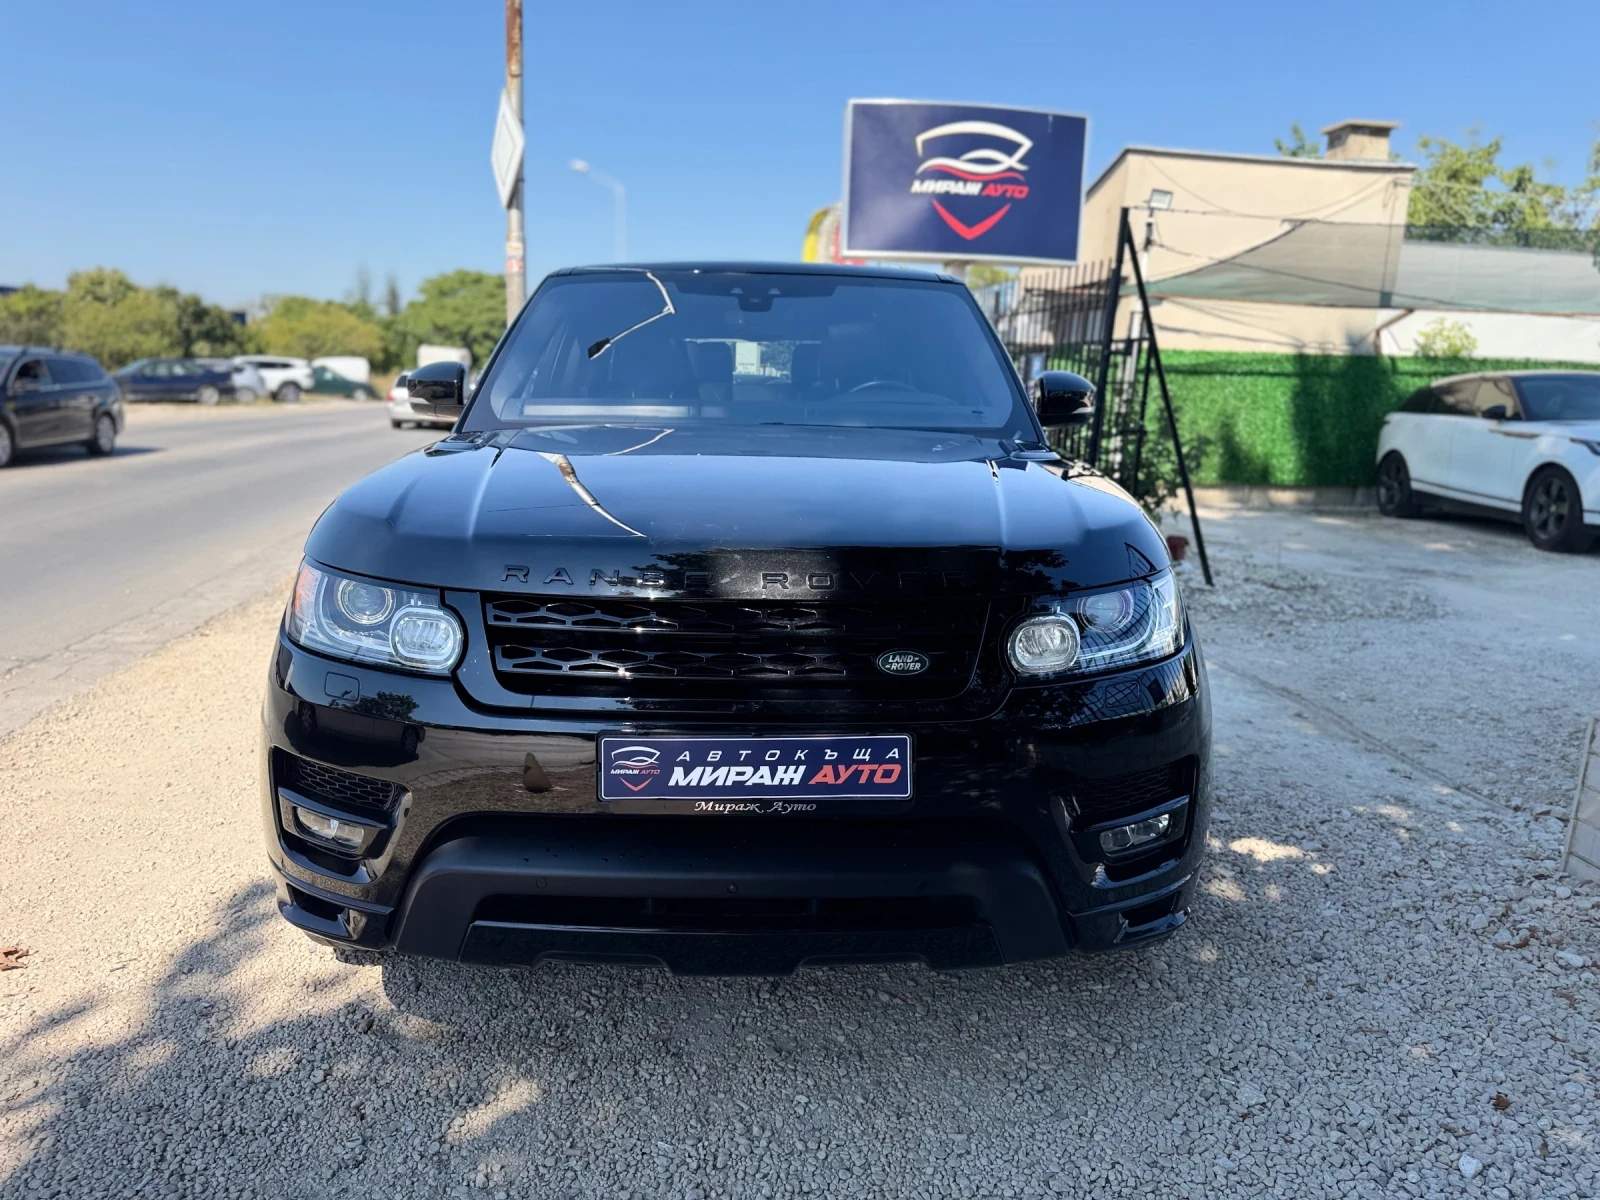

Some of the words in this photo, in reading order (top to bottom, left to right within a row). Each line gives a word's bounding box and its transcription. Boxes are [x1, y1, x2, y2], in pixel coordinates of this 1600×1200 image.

[910, 179, 983, 196] МИРАЖ
[981, 182, 1030, 199] АУТО
[500, 564, 711, 589] RANGE
[888, 654, 914, 663] LAND
[890, 662, 922, 671] ROVER
[676, 747, 900, 762] АВТОКЪЩА
[667, 764, 807, 787] МИРАЖ
[808, 763, 902, 785] АУТО
[694, 800, 764, 815] Мираж
[766, 800, 818, 815] Ауто
